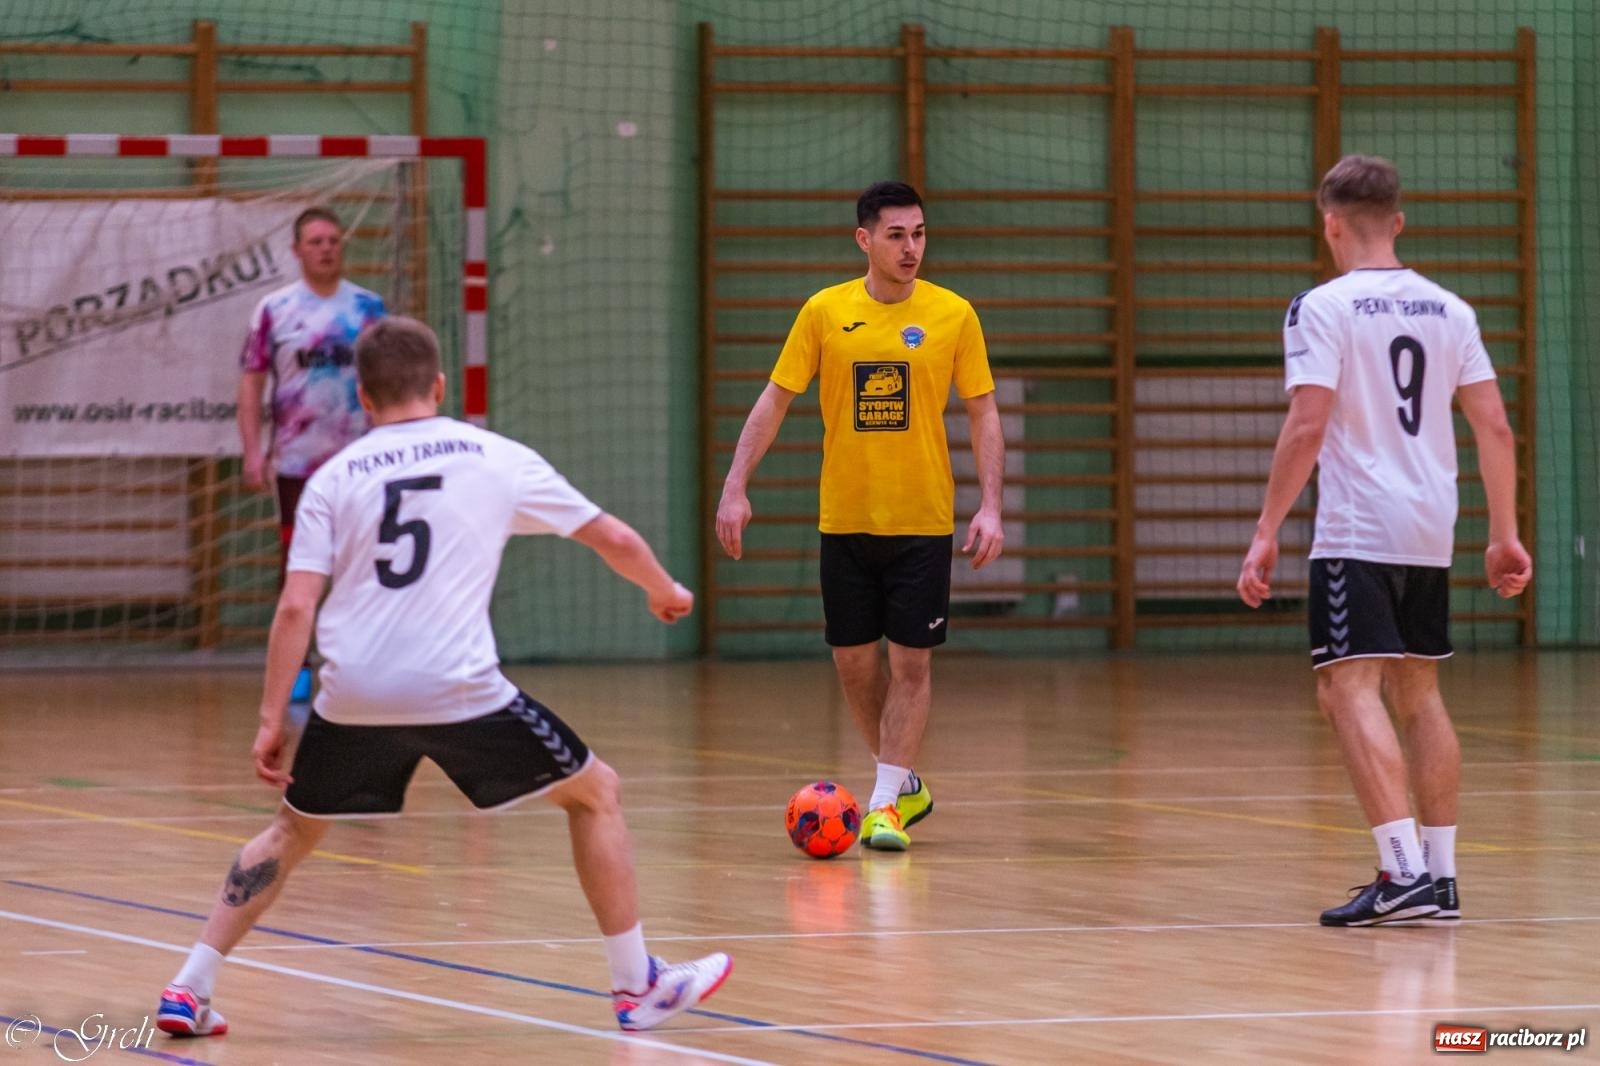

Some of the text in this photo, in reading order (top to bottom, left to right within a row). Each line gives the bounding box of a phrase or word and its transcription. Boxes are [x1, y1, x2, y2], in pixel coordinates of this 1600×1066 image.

[15, 242, 278, 355] PORZĄDKU!
[858, 401, 904, 410] STOPIW
[858, 411, 904, 421] GARAGE
[1389, 335, 1426, 437] 9
[348, 439, 485, 476] PIĘKNY TRAWNIK
[374, 474, 443, 590] 5
